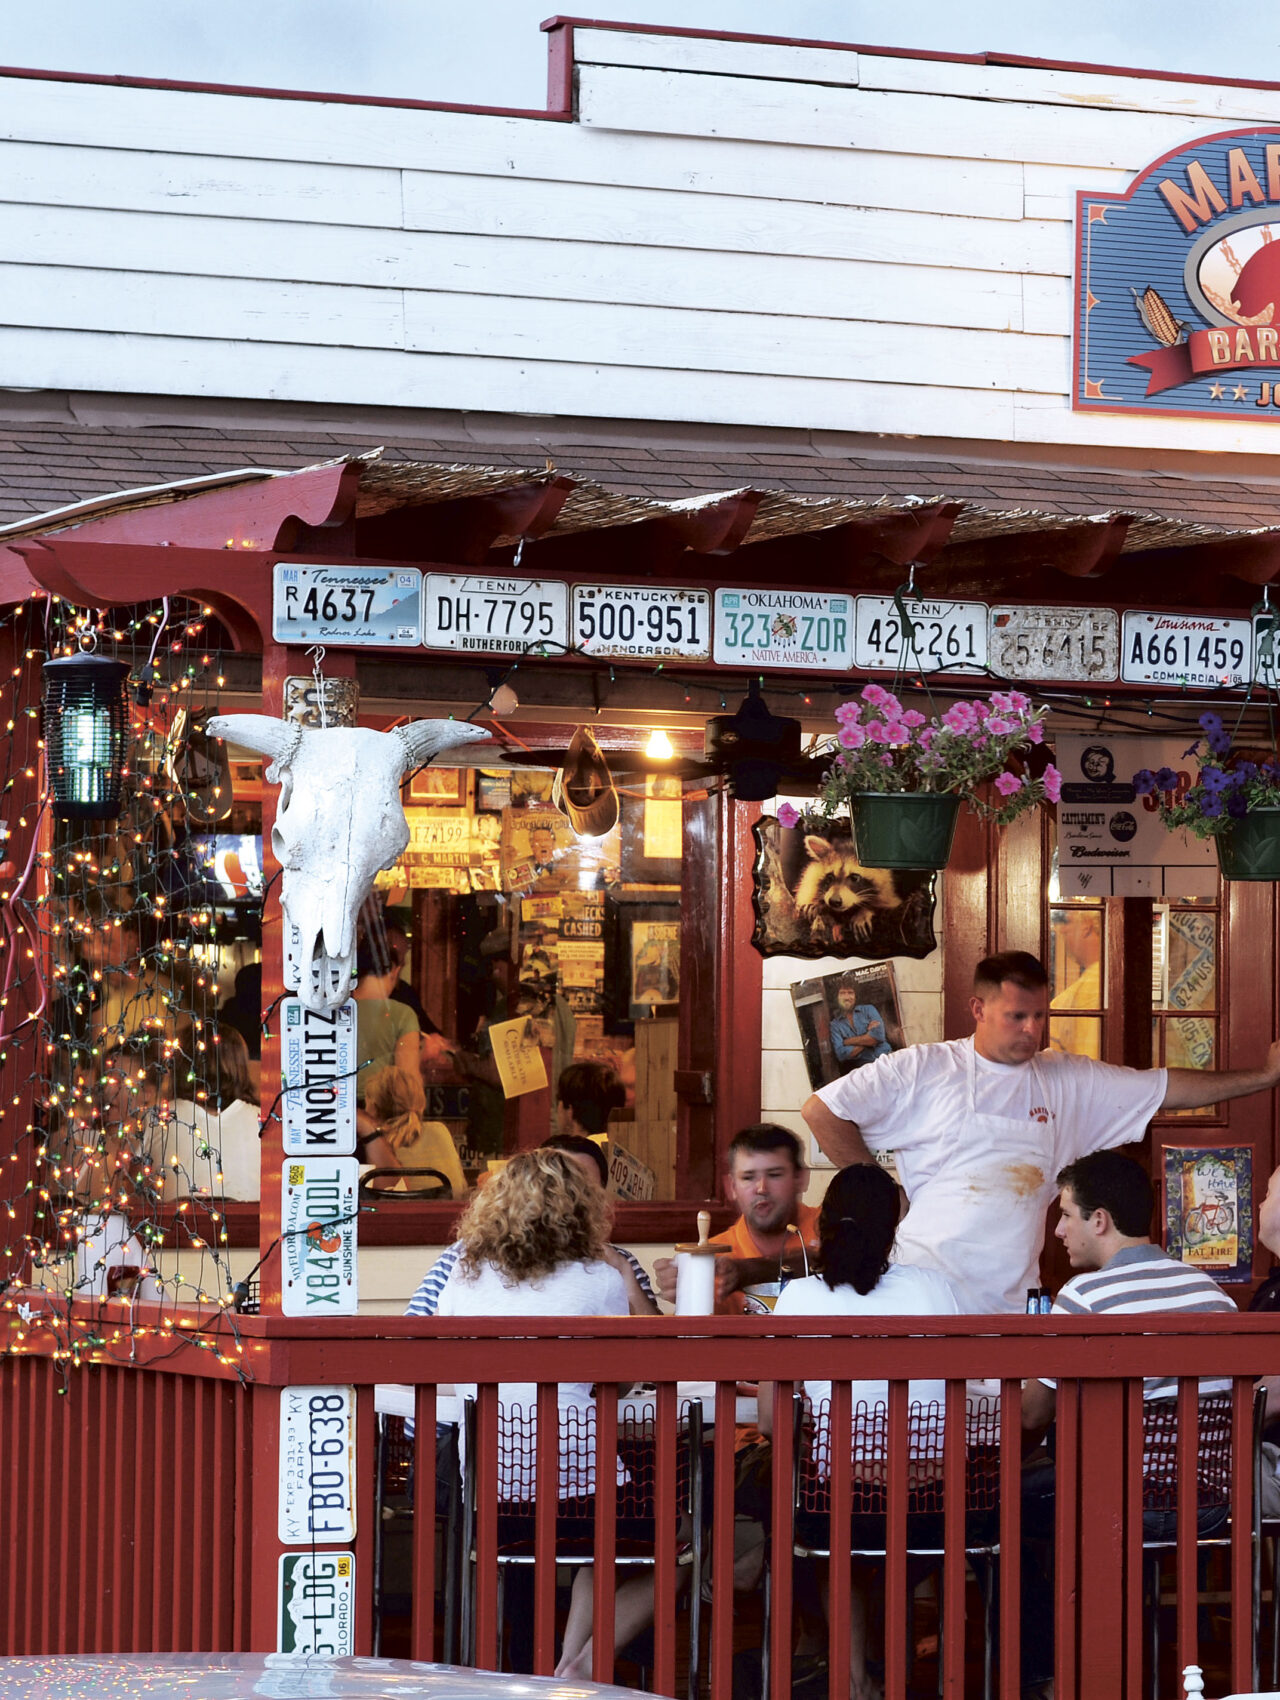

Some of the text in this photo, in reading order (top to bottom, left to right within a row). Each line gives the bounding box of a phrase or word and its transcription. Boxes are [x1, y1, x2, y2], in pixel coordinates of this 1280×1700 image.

[283, 570, 298, 582] MAR
[312, 569, 388, 585] Tennessee
[477, 580, 517, 592] TENN
[304, 587, 375, 622] 4637
[605, 591, 677, 602] KENTUCKY
[748, 593, 822, 609] OKLAHOMA
[320, 627, 376, 637] Radnor Lake
[725, 612, 770, 649] 323
[1093, 621, 1108, 631] 62
[1154, 617, 1220, 632] Louisiana
[463, 638, 528, 651] RUTHERFORD
[601, 644, 679, 655] HENDERSON
[1131, 632, 1244, 670] A661459
[752, 650, 818, 664] NATIVE AMERICA
[1152, 671, 1219, 684] COMMERCIAL
[433, 854, 470, 865] MARTIN
[1070, 845, 1130, 859] Budweiser
[563, 921, 602, 937] CASHED
[304, 1009, 337, 1145] KNOTHIZ
[339, 1042, 348, 1109] WILLIAMSON
[290, 1127, 301, 1145] MAY
[342, 1193, 353, 1279] SUNSHINE STATE
[1188, 1246, 1233, 1257] FAT TIRE
[288, 1393, 303, 1414] KY
[286, 1427, 296, 1477] 3-31-93
[296, 1441, 305, 1490] FARM
[287, 1517, 301, 1538] KY
[337, 1562, 349, 1656] OLORADO 06
